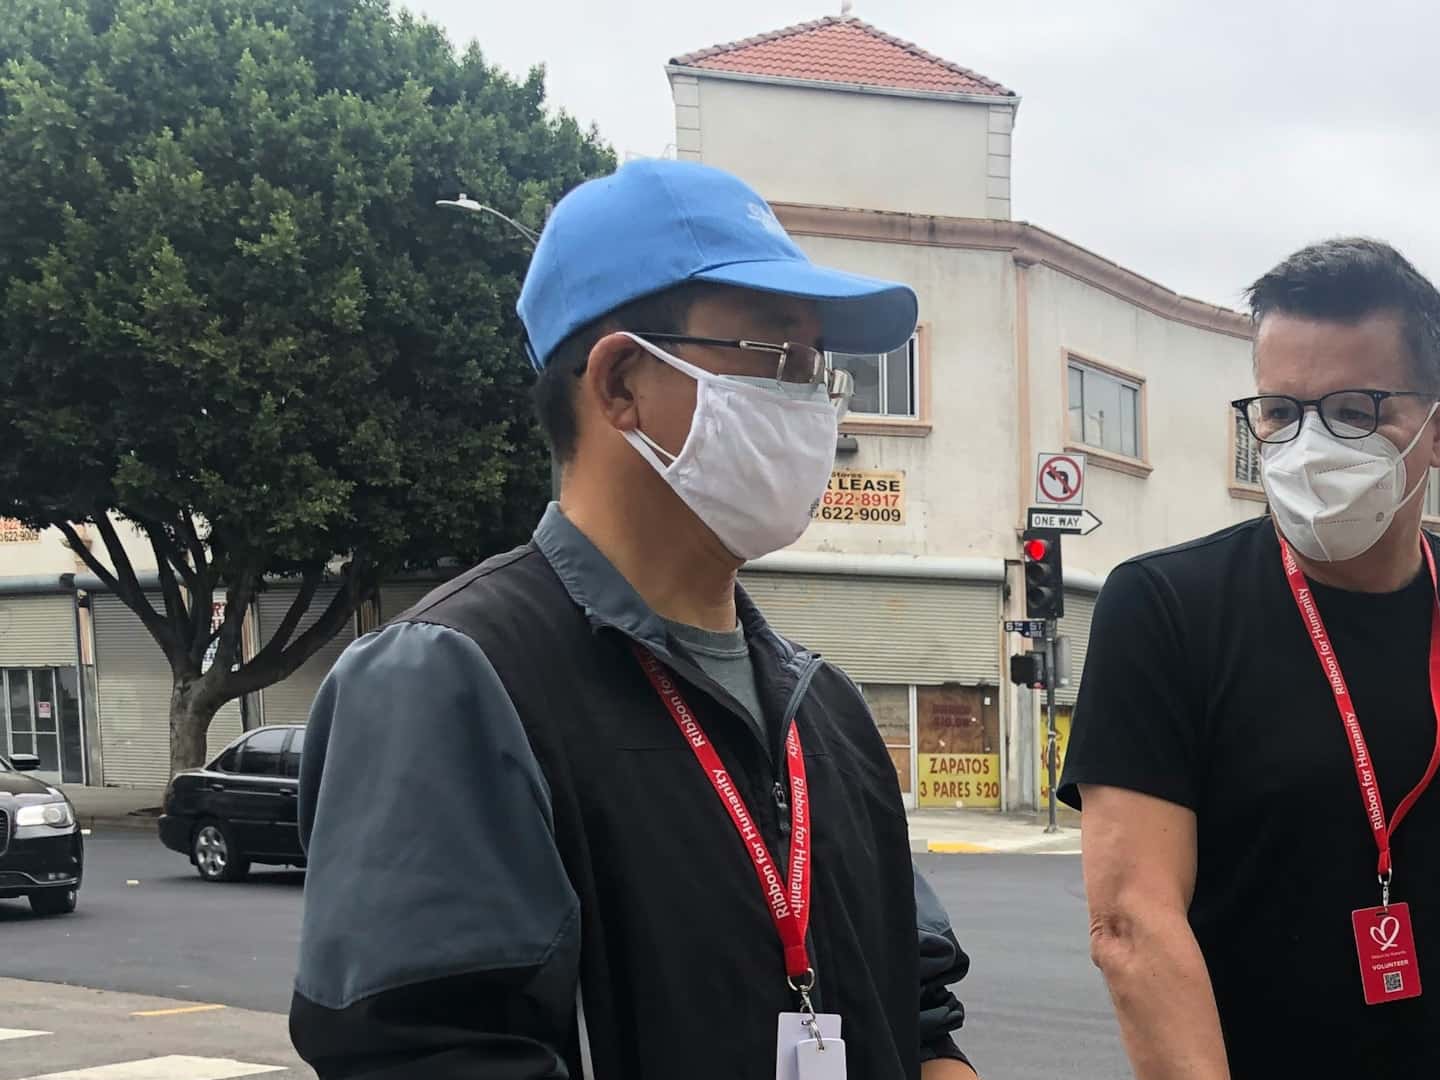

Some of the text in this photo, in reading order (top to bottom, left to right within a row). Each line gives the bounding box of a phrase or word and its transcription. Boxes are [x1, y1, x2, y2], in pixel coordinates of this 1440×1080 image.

[838, 478, 900, 492] LEASE
[823, 491, 900, 507] 622-8917
[821, 506, 901, 522] 622-9009
[1033, 515, 1080, 527] ONE WAY
[1297, 588, 1345, 695] Ribbon for Humanity
[671, 696, 706, 748] Ribbon
[930, 758, 990, 774] ZAPATOS
[1346, 712, 1383, 830] Ribbon for Humanity
[920, 781, 999, 798] 3 PARES $20
[713, 769, 790, 919] Ribbon for Humanity
[791, 776, 807, 918] Ribbon for Humanity
[1371, 960, 1409, 971] VOLUNTEER
